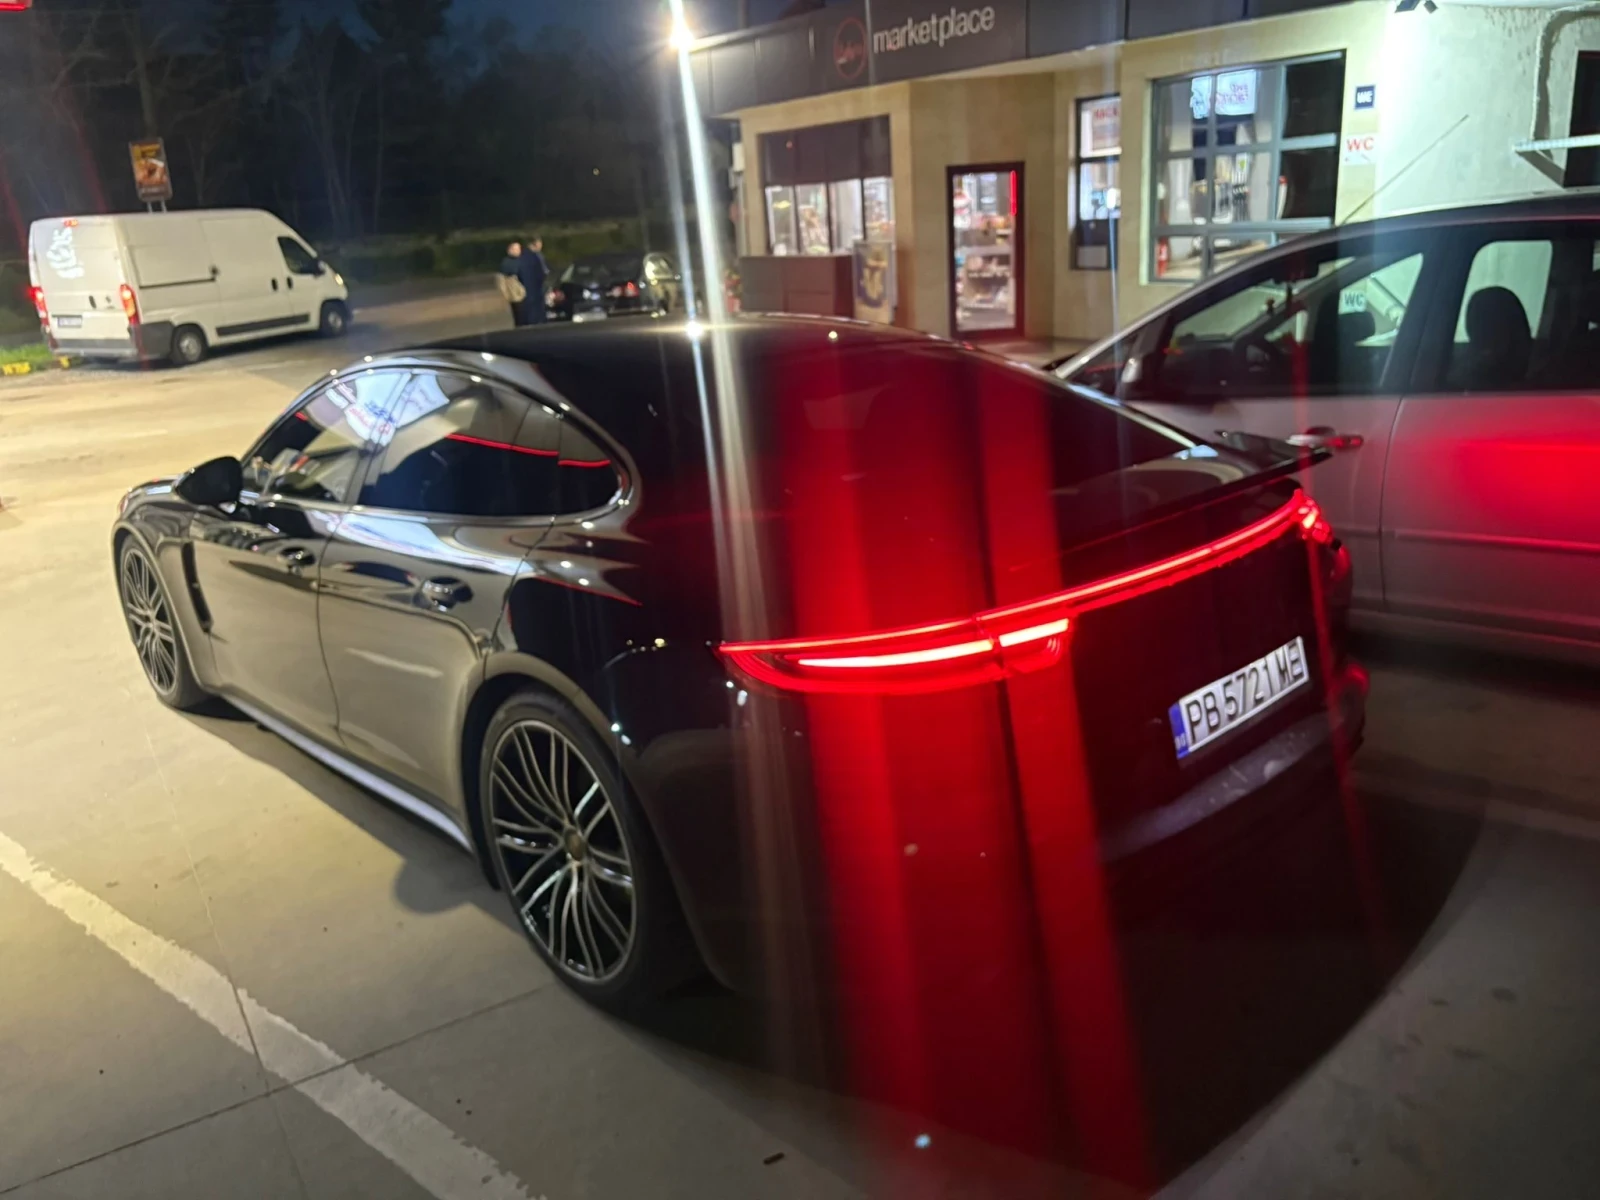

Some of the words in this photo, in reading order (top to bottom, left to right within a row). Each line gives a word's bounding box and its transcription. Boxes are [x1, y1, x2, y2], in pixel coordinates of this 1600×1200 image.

[873, 6, 995, 54] marketplace
[1346, 136, 1375, 151] WC
[1344, 292, 1365, 307] WC
[1185, 692, 1221, 744] PB
[1222, 661, 1274, 720] 5721
